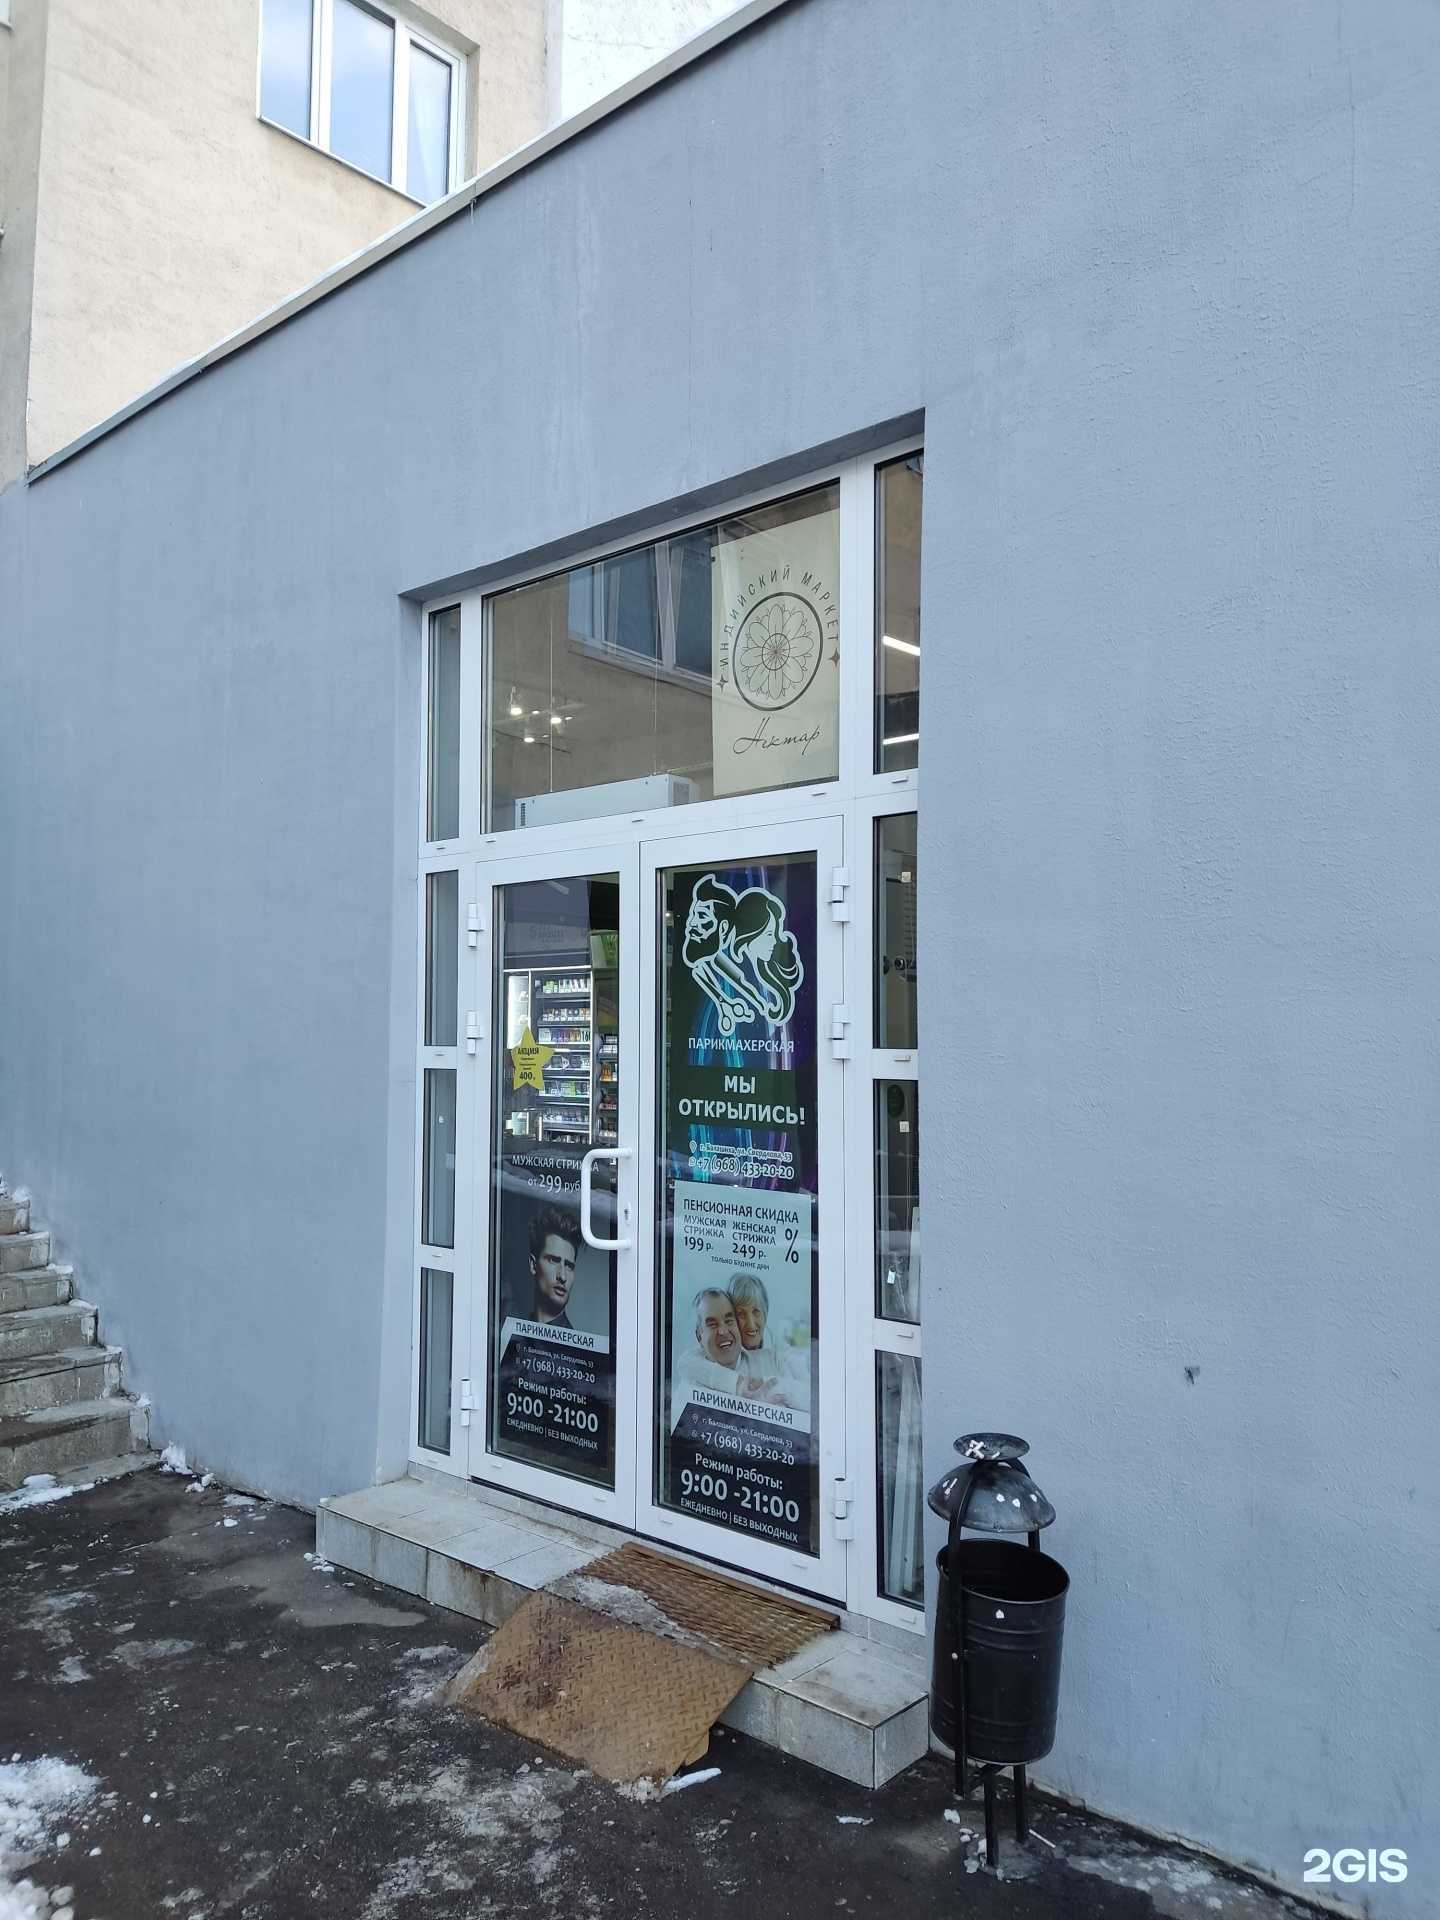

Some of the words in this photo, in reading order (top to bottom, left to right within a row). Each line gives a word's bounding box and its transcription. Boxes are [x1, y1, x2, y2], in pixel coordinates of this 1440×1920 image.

[720, 564, 791, 668] ИНДИЙСКИЙ
[801, 572, 840, 641] МАРКЕТ
[518, 1048, 539, 1056] АКЦИЯ
[688, 1038, 794, 1052] ПАРИКМАХЕРСКАЯ
[724, 1076, 756, 1094] МЫ
[678, 1098, 805, 1125] ОТКРЫЛИСЬ!
[512, 1156, 554, 1168] МУЖСКАЯ
[556, 1158, 599, 1172] СТРИА
[697, 1158, 709, 1171] +7
[711, 1154, 740, 1176] (968)
[742, 1162, 794, 1180] 433-20-20
[528, 1178, 536, 1186] от
[540, 1174, 562, 1194] 299
[684, 1199, 752, 1218] ПЕНСИОННАЯ
[756, 1207, 798, 1224] СКИДКА
[684, 1215, 726, 1228] МУЖСКАЯ
[684, 1225, 724, 1238] СТРИЖКА
[732, 1220, 776, 1234] ЖЕНСКАЯ
[732, 1232, 776, 1246] СТРИЖКА
[684, 1236, 704, 1252] 199
[732, 1243, 756, 1260] 249
[516, 1322, 594, 1348] ПАРИКМАХЕРСКАЯ
[522, 1359, 530, 1370] +7
[533, 1358, 554, 1376] (968)
[556, 1366, 595, 1383] 433-20-20
[518, 1378, 548, 1395] Режим
[550, 1386, 586, 1405] работы:
[507, 1393, 543, 1417] 9:00
[692, 1390, 793, 1425] ПАРИКМАХЕРСКАЯ
[507, 1418, 543, 1434] ЕЖЕДНЕВНО
[548, 1429, 559, 1438] БЕЗ
[560, 1432, 598, 1450] ВЫХОДНЫХ
[700, 1432, 712, 1444] +7
[714, 1432, 742, 1454] (968)
[745, 1444, 794, 1466] 433-20-20
[696, 1453, 734, 1474] Режим
[736, 1466, 782, 1490] работы:
[681, 1469, 728, 1501] 9:00
[680, 1498, 727, 1520] ЕЖЕДНЕВНО
[734, 1515, 748, 1528] БЕЗ
[750, 1520, 798, 1542] ВЫХОДНЫХ
